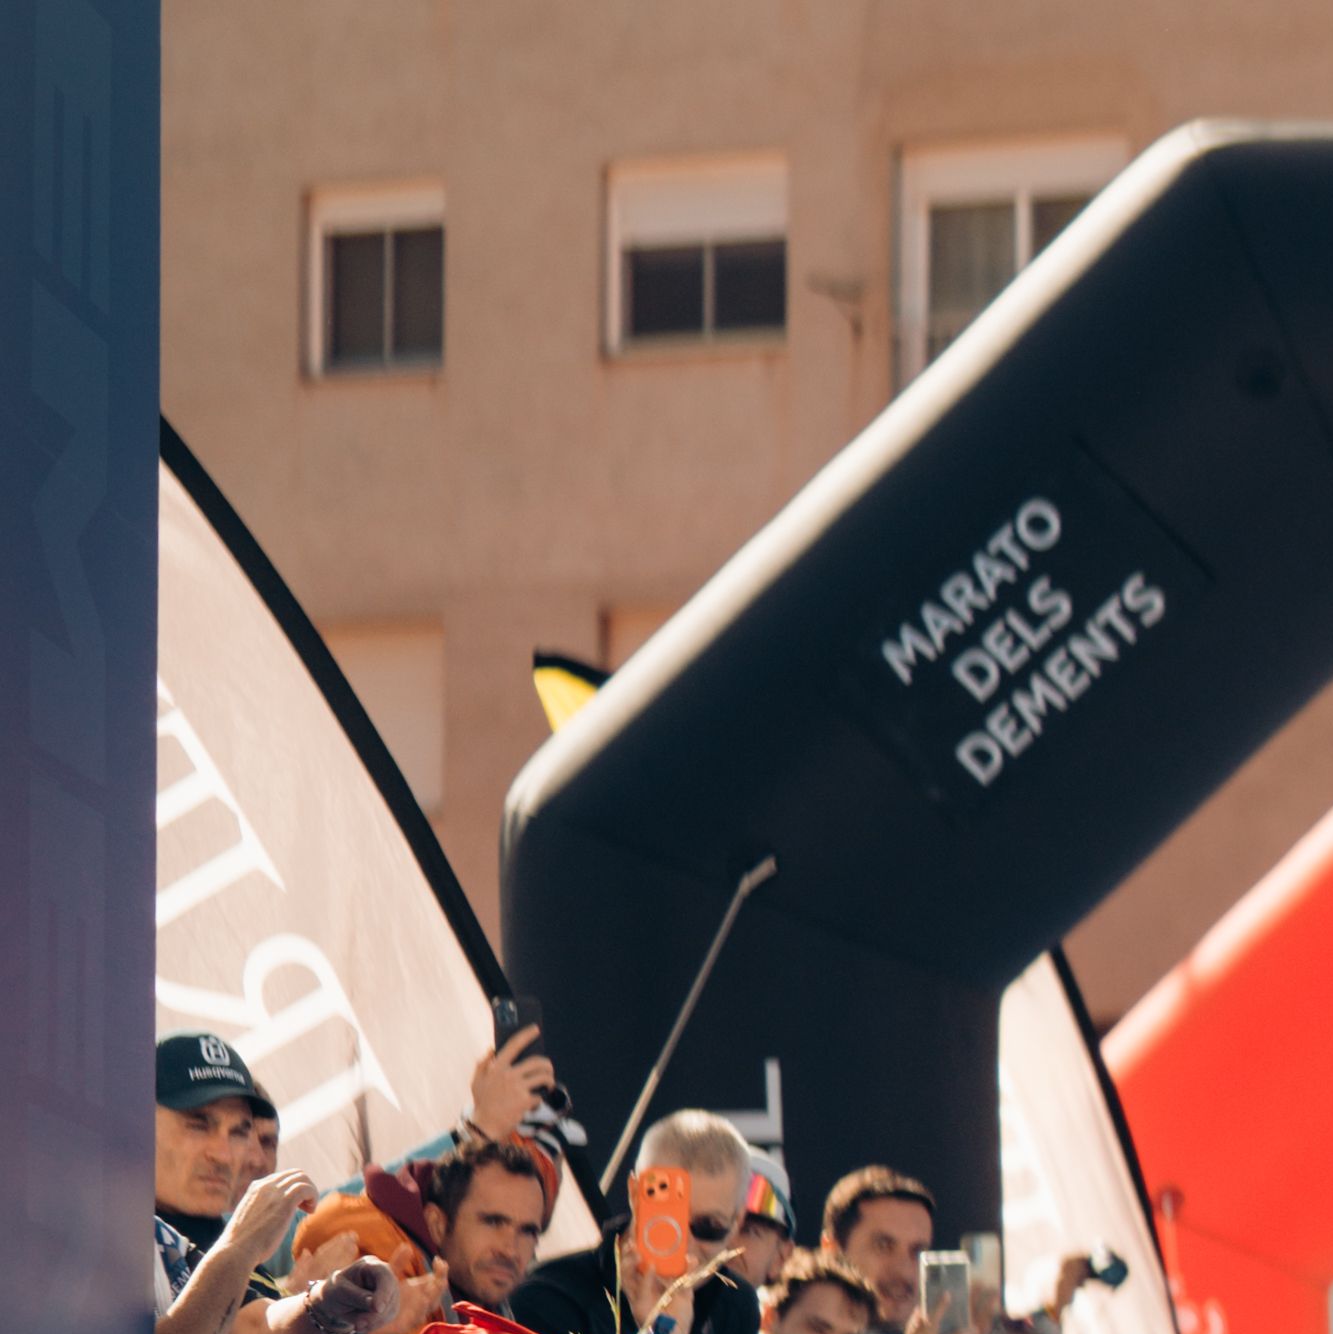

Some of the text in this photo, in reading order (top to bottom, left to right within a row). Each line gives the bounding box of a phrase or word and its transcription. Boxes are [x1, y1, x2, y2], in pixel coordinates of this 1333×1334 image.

[881, 496, 1062, 686] MARATO
[951, 574, 1073, 703] DELS
[954, 571, 1166, 787] DEMENTS
